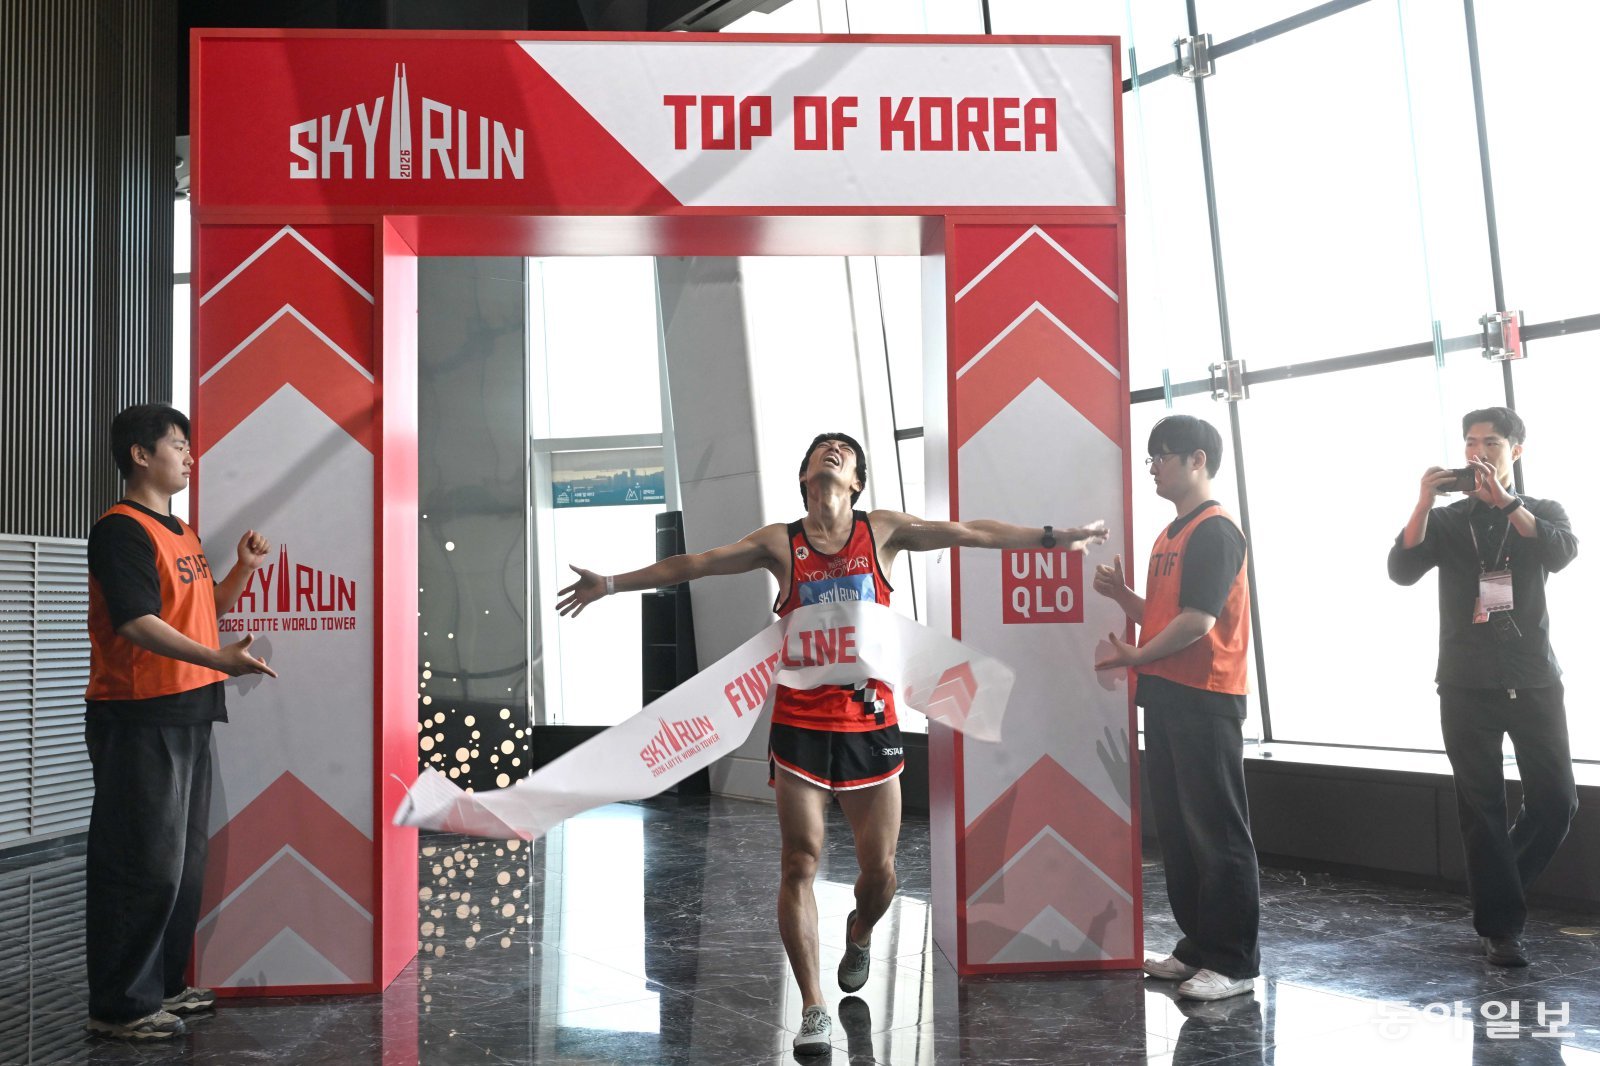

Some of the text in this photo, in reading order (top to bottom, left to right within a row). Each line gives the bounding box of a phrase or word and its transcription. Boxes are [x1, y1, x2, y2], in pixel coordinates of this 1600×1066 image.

[289, 95, 525, 180] SKY RUN
[663, 94, 1058, 152] TOP OF KOREA
[400, 149, 411, 178] 2026
[176, 554, 212, 585] STAF
[804, 556, 869, 582] YOKOMORI
[1011, 552, 1068, 579] UNI
[229, 562, 356, 614] KY RUN
[818, 586, 859, 604] SKY RUN
[1012, 585, 1074, 618] QLO
[218, 616, 356, 633] 2026 LOTTE WORLD TOWER
[781, 625, 857, 667] LINE
[640, 715, 715, 768] SKY RUN
[664, 755, 683, 771] LOTTE
[682, 744, 701, 761] WORLD
[699, 732, 720, 749] TOWER
